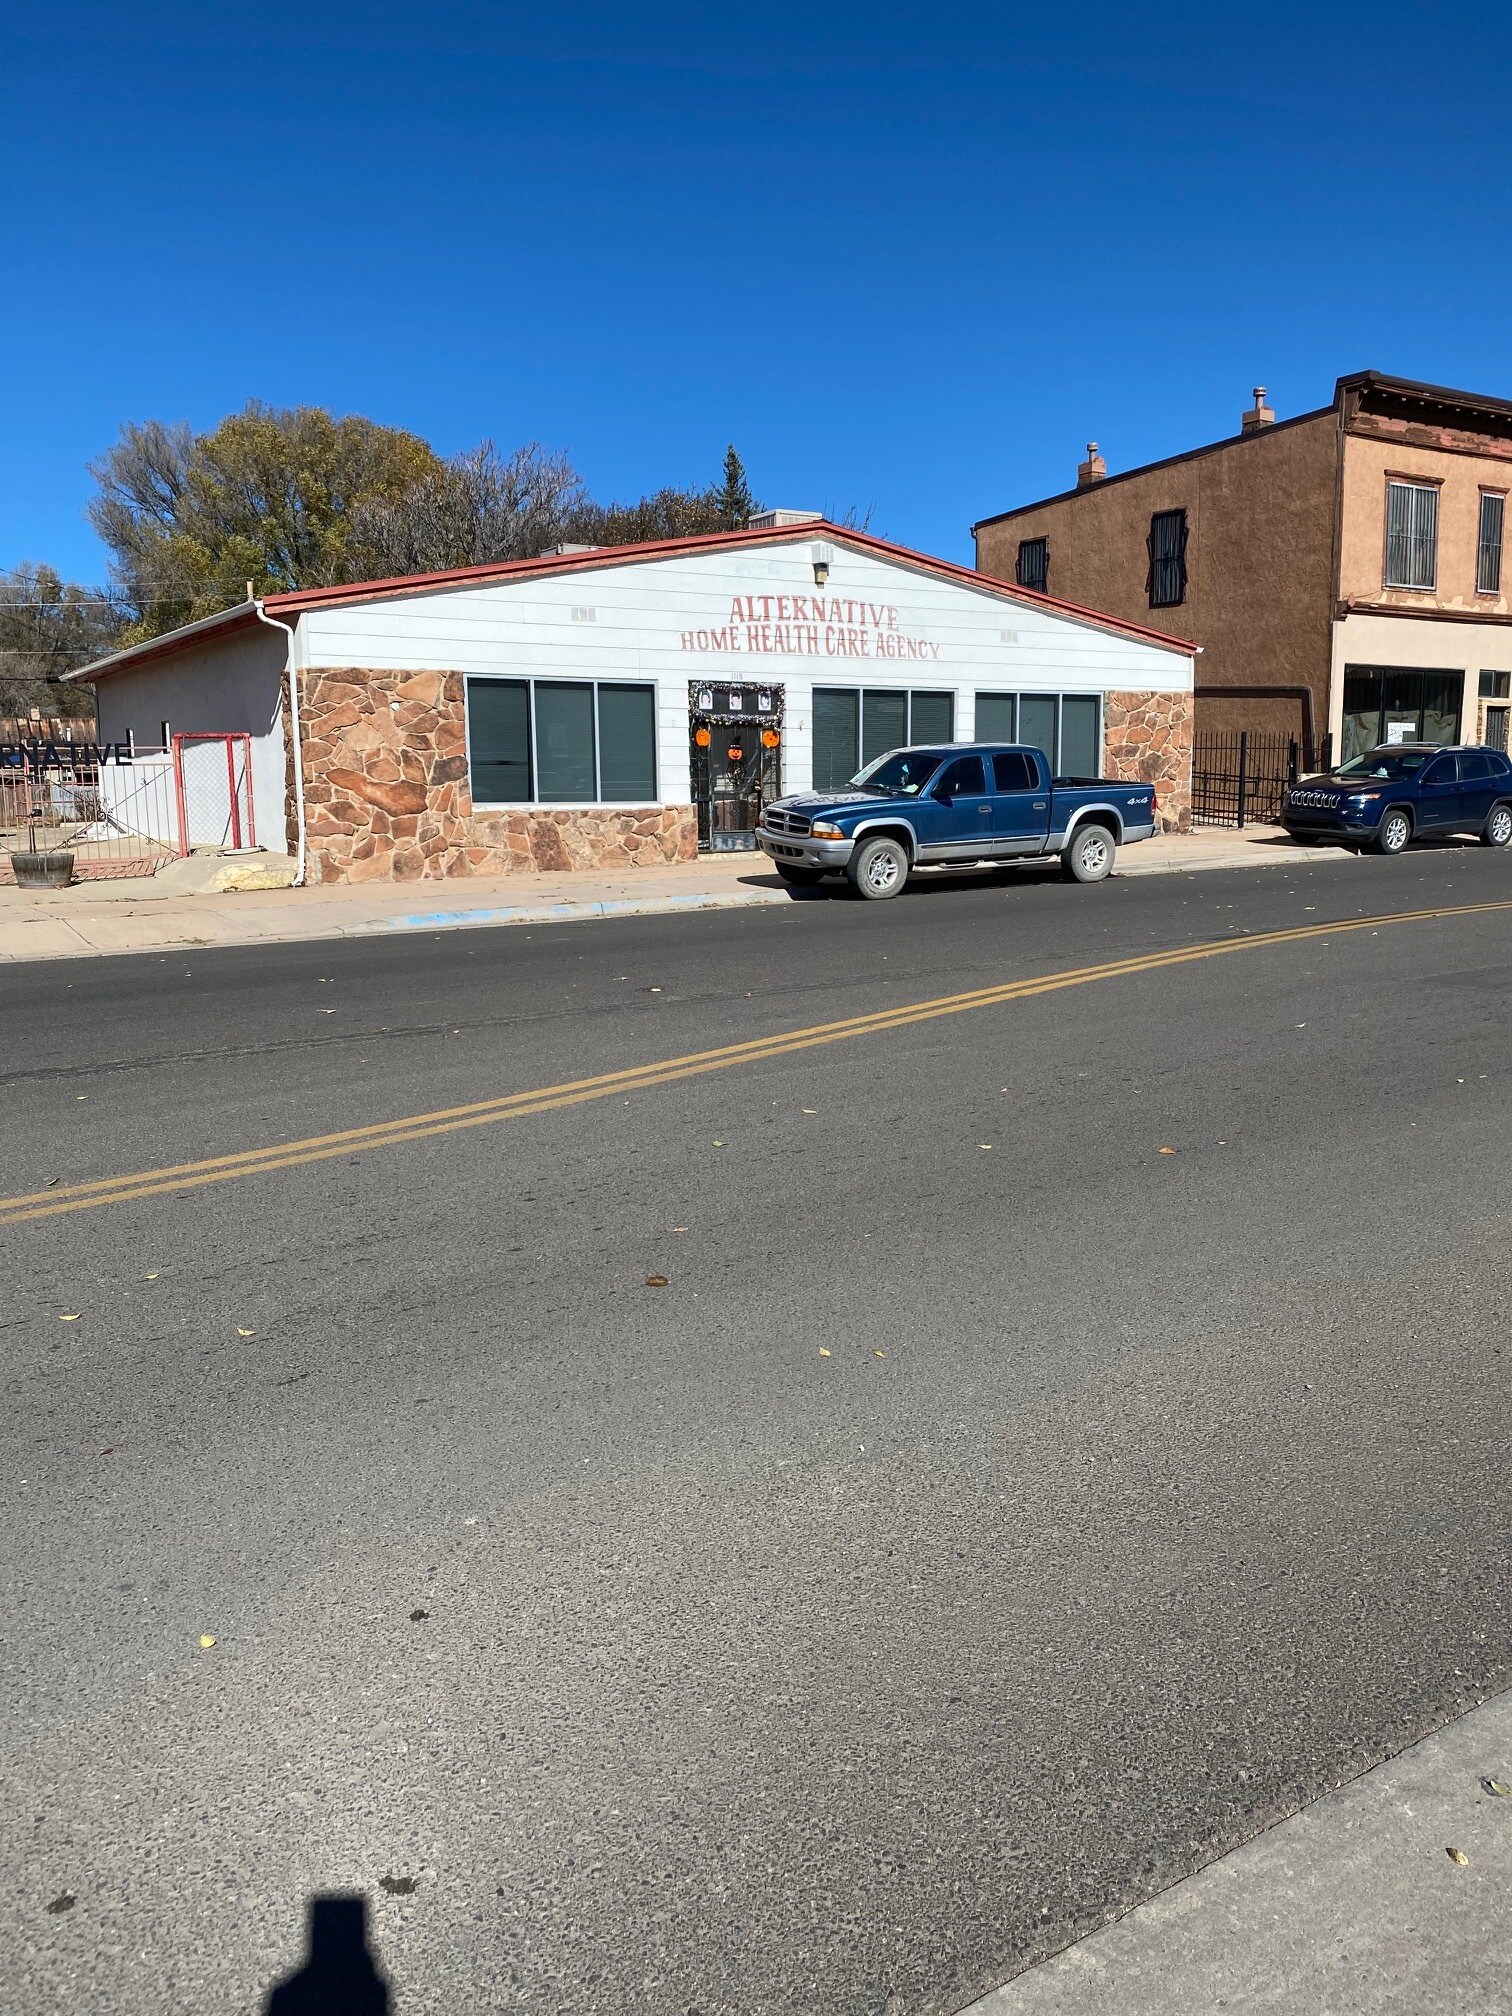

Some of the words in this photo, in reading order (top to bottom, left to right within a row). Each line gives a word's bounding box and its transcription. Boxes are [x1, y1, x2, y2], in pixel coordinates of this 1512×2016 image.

[729, 595, 900, 632] ALTERNATIVE
[680, 628, 741, 652] HOME
[746, 624, 820, 655] HEALTH
[825, 624, 871, 657] CARE
[876, 631, 940, 660] AGENCY
